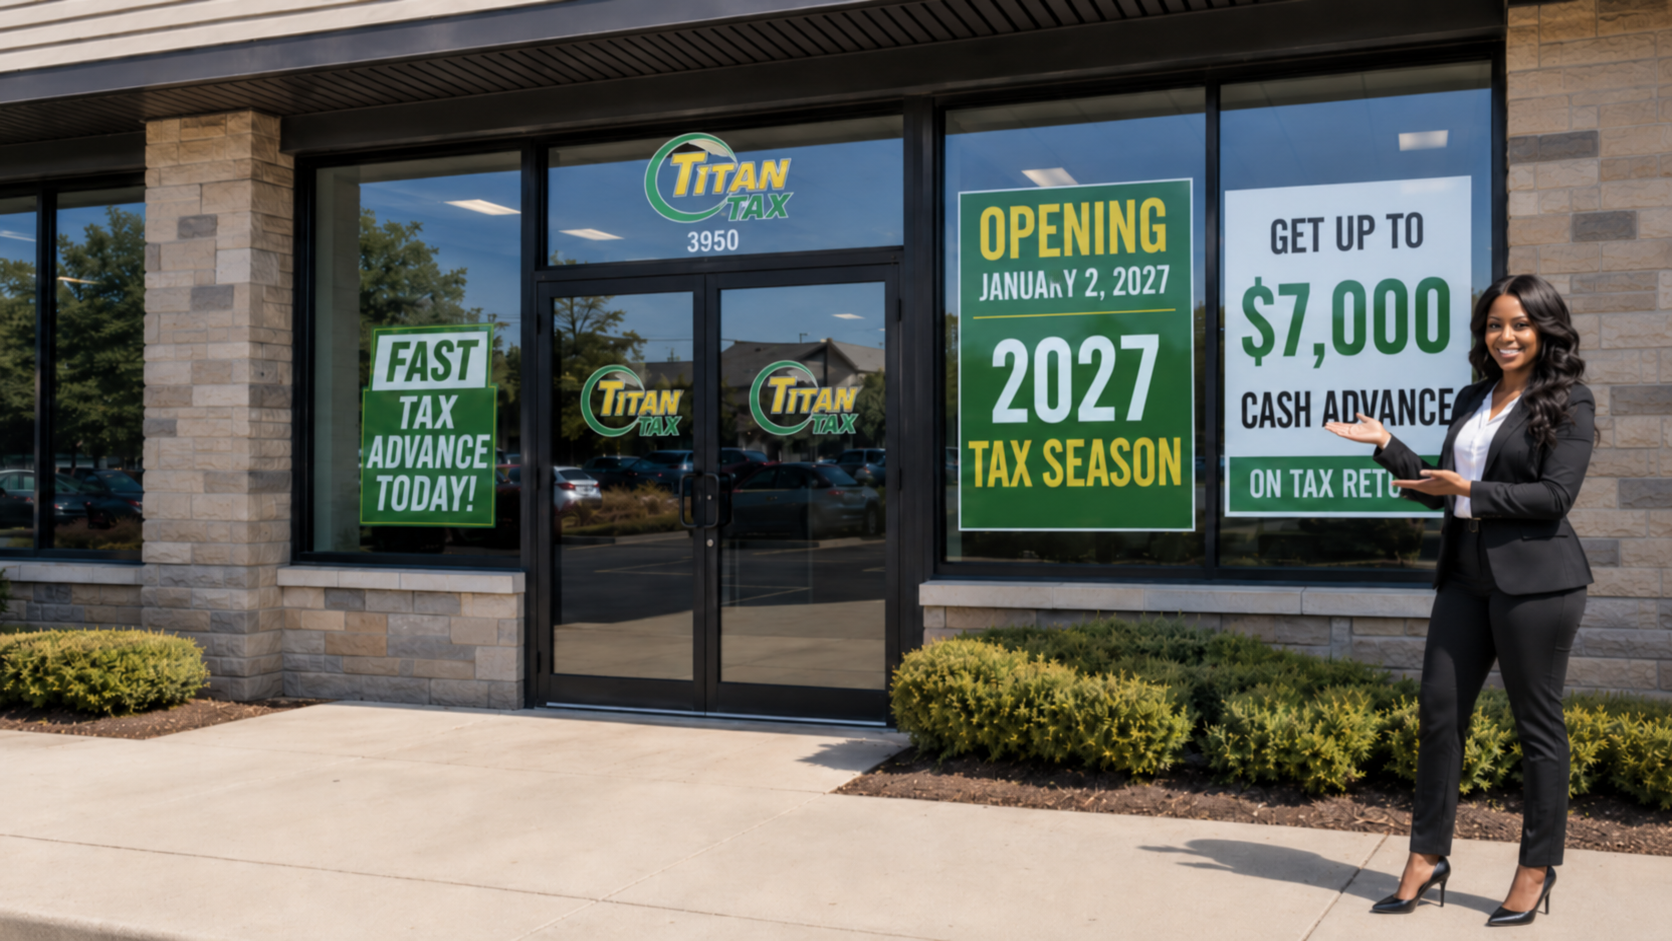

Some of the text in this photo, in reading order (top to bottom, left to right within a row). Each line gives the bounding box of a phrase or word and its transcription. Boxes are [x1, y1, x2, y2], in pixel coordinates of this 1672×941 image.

[670, 151, 792, 198] TITAN
[726, 192, 794, 222] TAX
[686, 229, 740, 253] 3950
[979, 197, 1167, 261] OPENING
[1270, 211, 1424, 253] GET UP TO
[1085, 267, 1105, 301] 2,
[1112, 264, 1170, 297] 2027
[1241, 276, 1451, 369] $7,000
[386, 339, 479, 382] FAST
[992, 334, 1160, 424] 2027
[399, 395, 458, 429] TAX
[597, 379, 684, 416] TITAN
[768, 375, 861, 415] TITAN
[1241, 388, 1454, 429] CASH ADVANCE
[638, 415, 682, 437] TAX
[811, 413, 859, 436] TAX
[367, 434, 490, 469] ADVANCE
[968, 437, 1182, 488] TAX SEASON
[376, 474, 476, 512] TODAY!
[1249, 469, 1401, 499] ON TAX RETU
